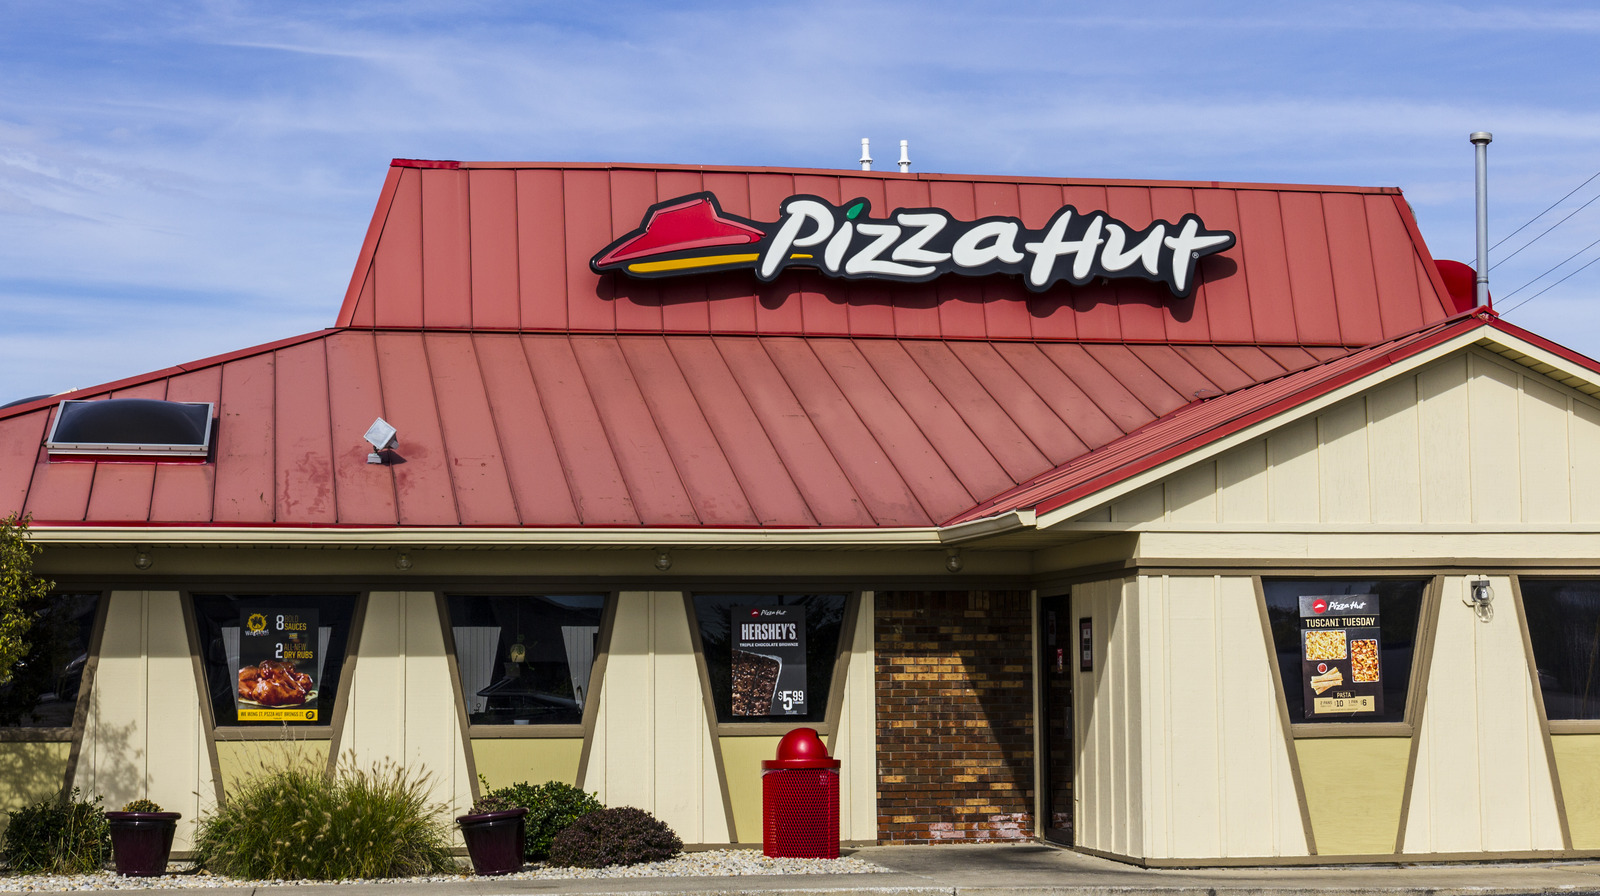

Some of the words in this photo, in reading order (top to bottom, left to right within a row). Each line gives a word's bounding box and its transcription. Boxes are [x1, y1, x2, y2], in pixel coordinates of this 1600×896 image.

[761, 199, 1025, 277] Pizza
[1024, 210, 1231, 291] Hut
[1328, 601, 1349, 611] Pizza
[1348, 601, 1367, 610] Hut
[276, 614, 284, 630] 8
[1305, 618, 1340, 628] TUSCANI
[1342, 617, 1376, 627] TUESDAY
[741, 623, 797, 640] HERSHEY'S
[276, 643, 283, 658] 2
